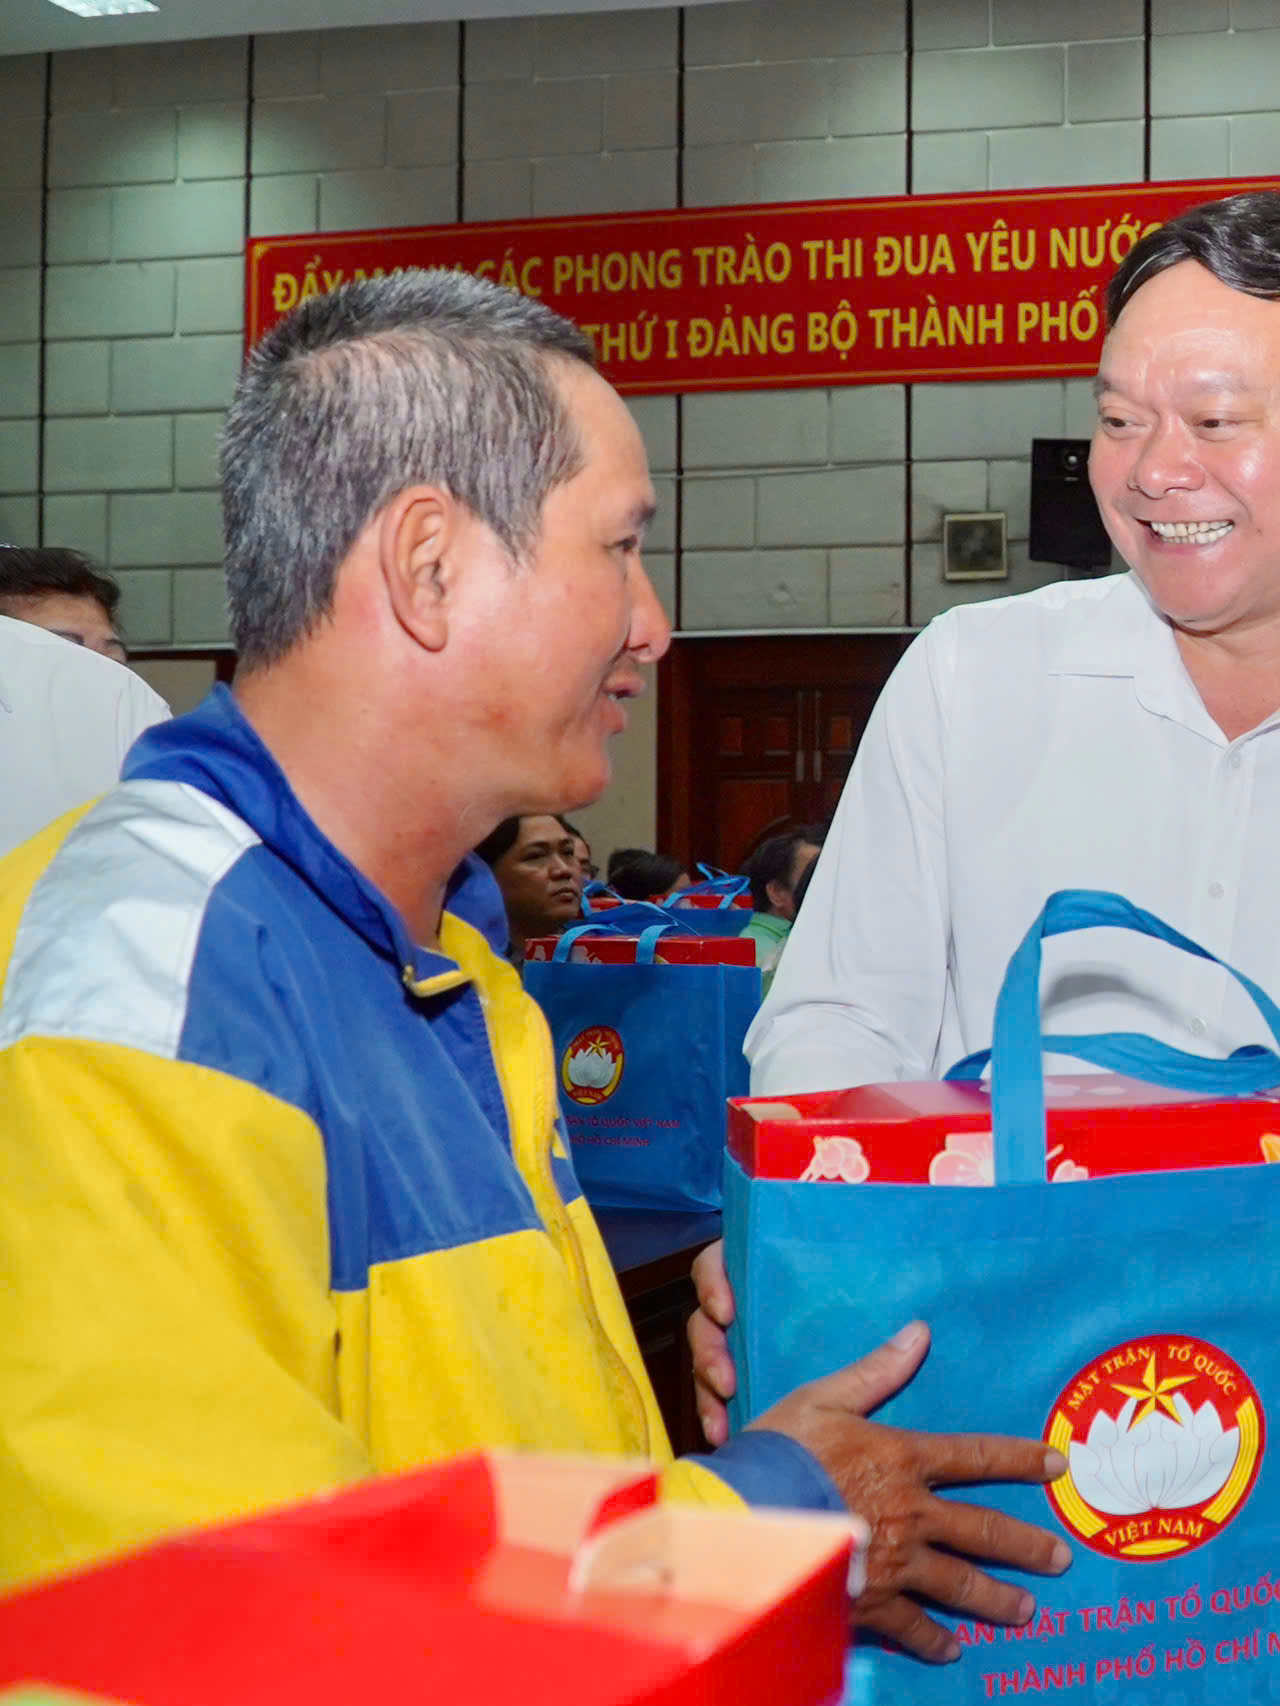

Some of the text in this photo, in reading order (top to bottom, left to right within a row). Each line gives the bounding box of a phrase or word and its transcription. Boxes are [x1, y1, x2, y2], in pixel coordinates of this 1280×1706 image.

[554, 248, 682, 297] PHONG
[692, 233, 793, 287] TRÀO
[802, 239, 864, 282] THI
[873, 234, 957, 278] ĐUA
[965, 219, 1037, 273] YÊU
[1049, 211, 1164, 270] NƯỚ
[665, 319, 679, 359] I
[686, 304, 796, 358] ĐẢNG
[806, 300, 859, 361] BỘ
[868, 294, 1006, 349] THÀNH
[1016, 285, 1100, 344] PHỐ
[1067, 1370, 1100, 1411] MẶT
[1102, 1346, 1150, 1375] TRẬN
[1194, 1354, 1237, 1396] QUỐC
[1104, 1517, 1204, 1547] VIỆT NAM
[953, 1621, 996, 1646] AN
[1077, 1597, 1156, 1633] TRẬN
[982, 1661, 1087, 1698] THÀNH
[1095, 1643, 1156, 1684] PHỐ
[1165, 1637, 1207, 1672] HỒ
[1215, 1628, 1261, 1664] CHÍ
